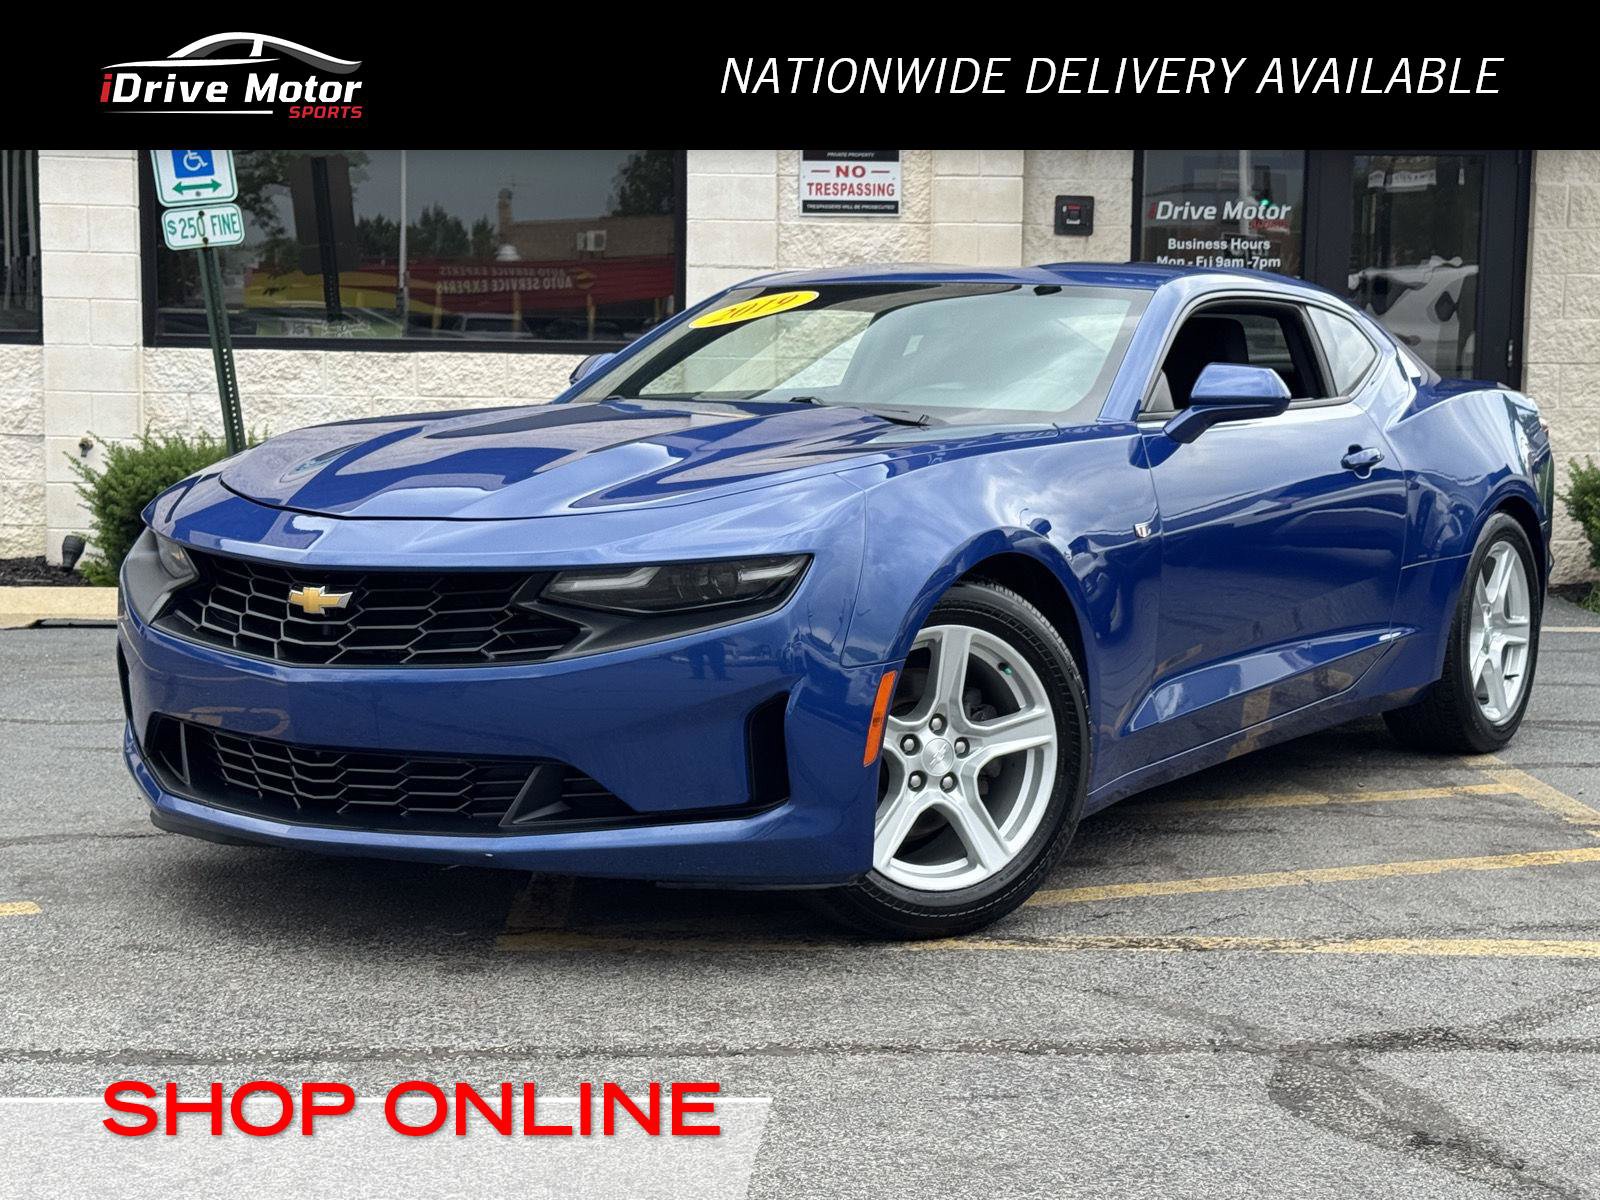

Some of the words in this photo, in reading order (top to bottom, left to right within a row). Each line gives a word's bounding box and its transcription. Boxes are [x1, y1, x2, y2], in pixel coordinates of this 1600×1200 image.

[835, 165, 866, 178] NO
[806, 182, 895, 197] TRESPASSING
[1222, 201, 1292, 221] Motor
[210, 213, 239, 236] FINE
[1168, 238, 1228, 250] Business
[1230, 238, 1271, 250] Hours
[1156, 255, 1185, 266] Mon
[1215, 255, 1245, 269] 9am
